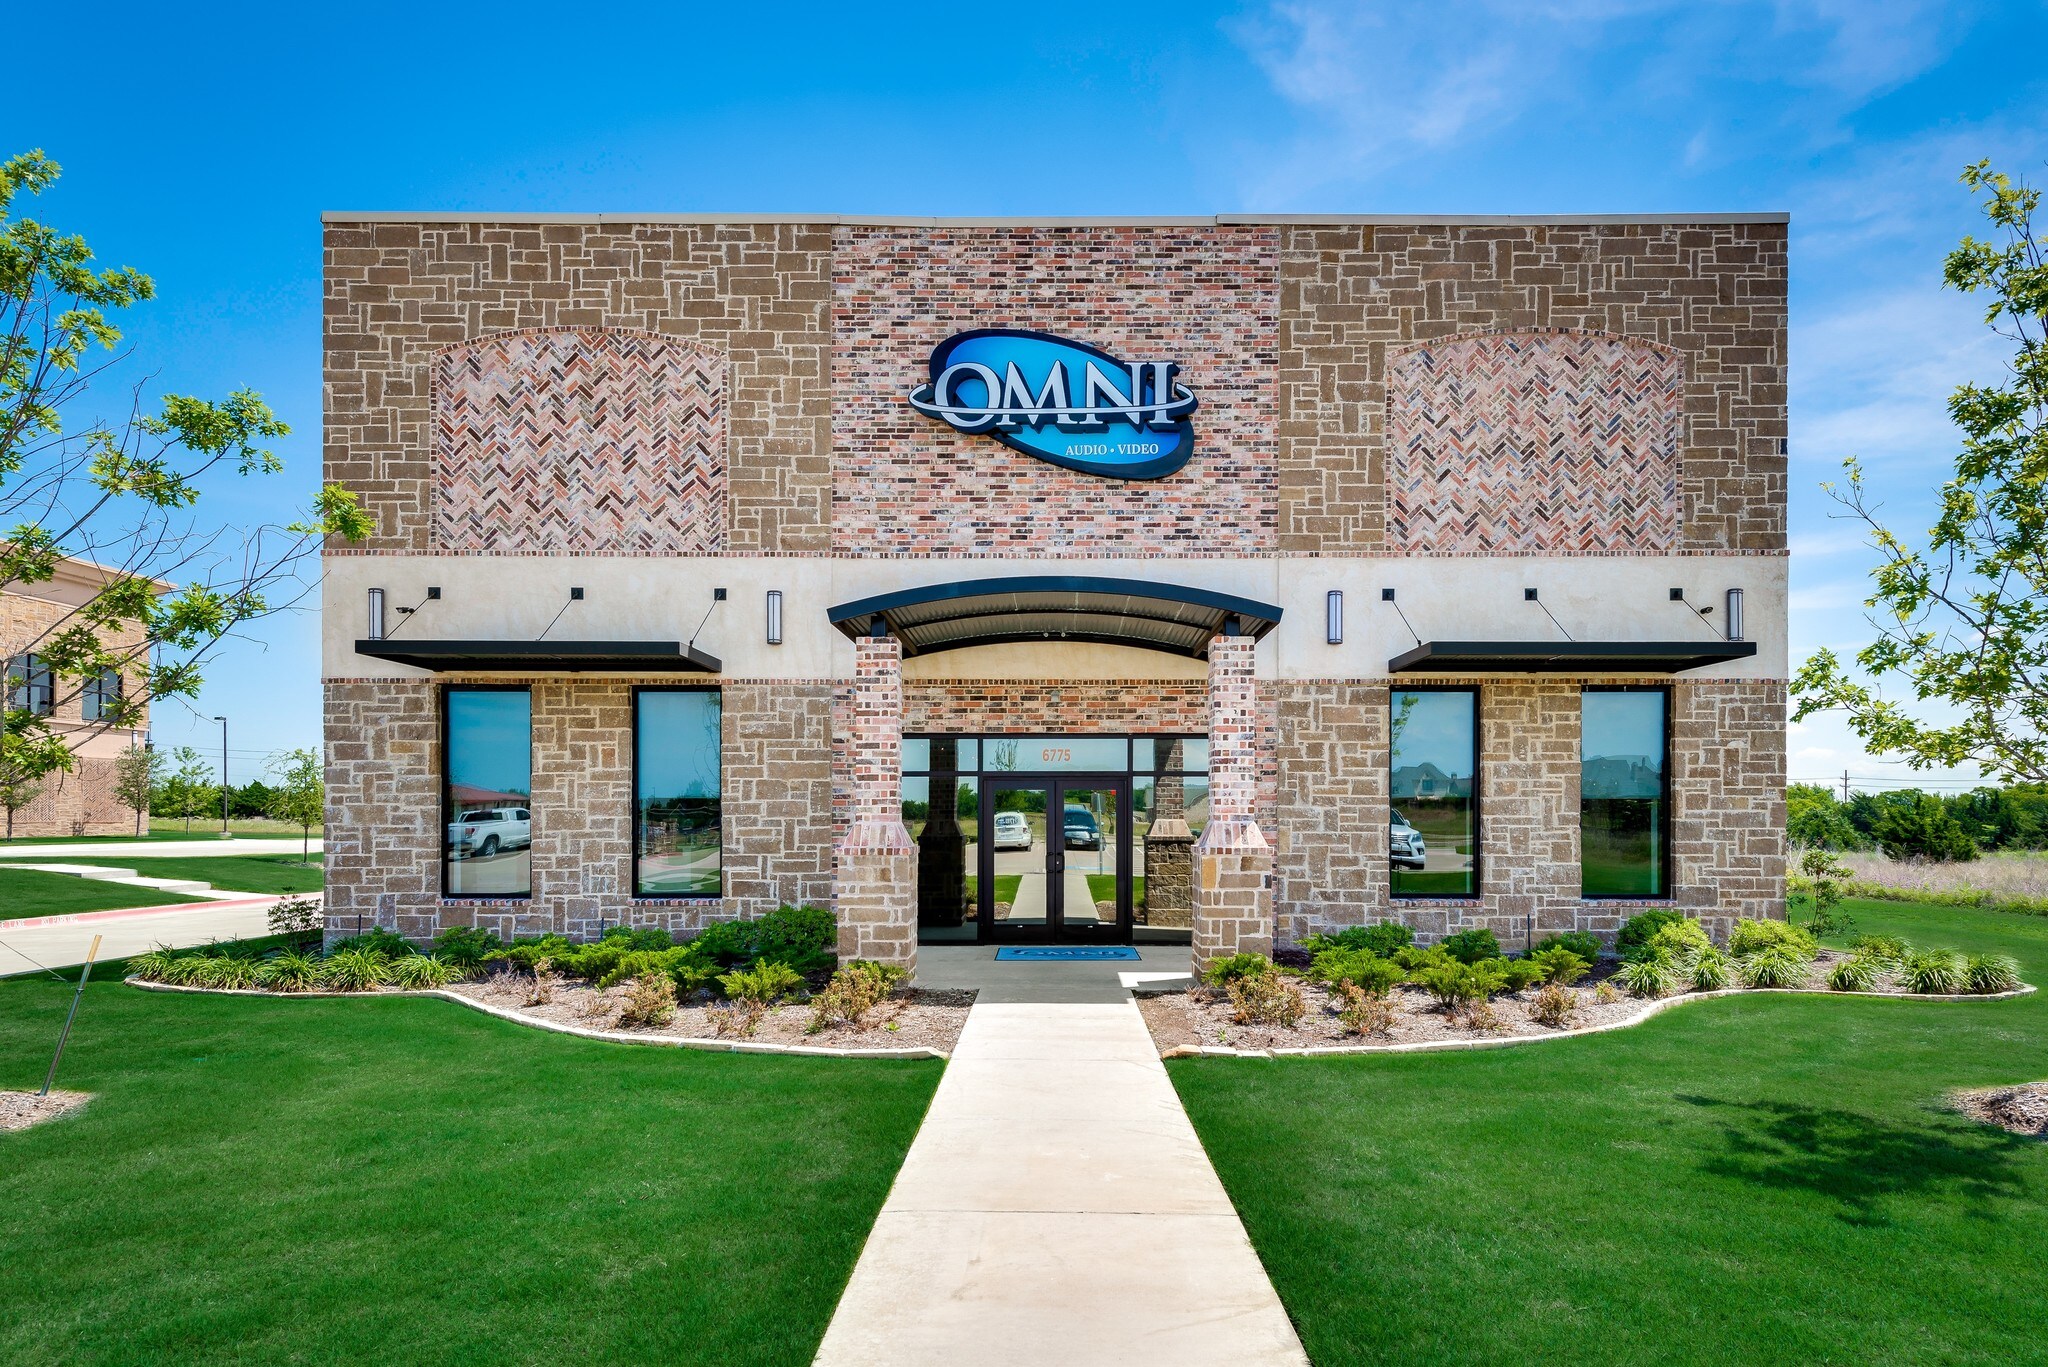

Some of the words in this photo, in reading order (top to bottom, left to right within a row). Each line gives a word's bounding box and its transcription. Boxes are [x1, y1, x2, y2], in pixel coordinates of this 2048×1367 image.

[934, 359, 1176, 427] OMNI
[1065, 444, 1109, 456] AUDIO
[1117, 443, 1159, 455] VIDEO
[1042, 748, 1071, 762] 6775
